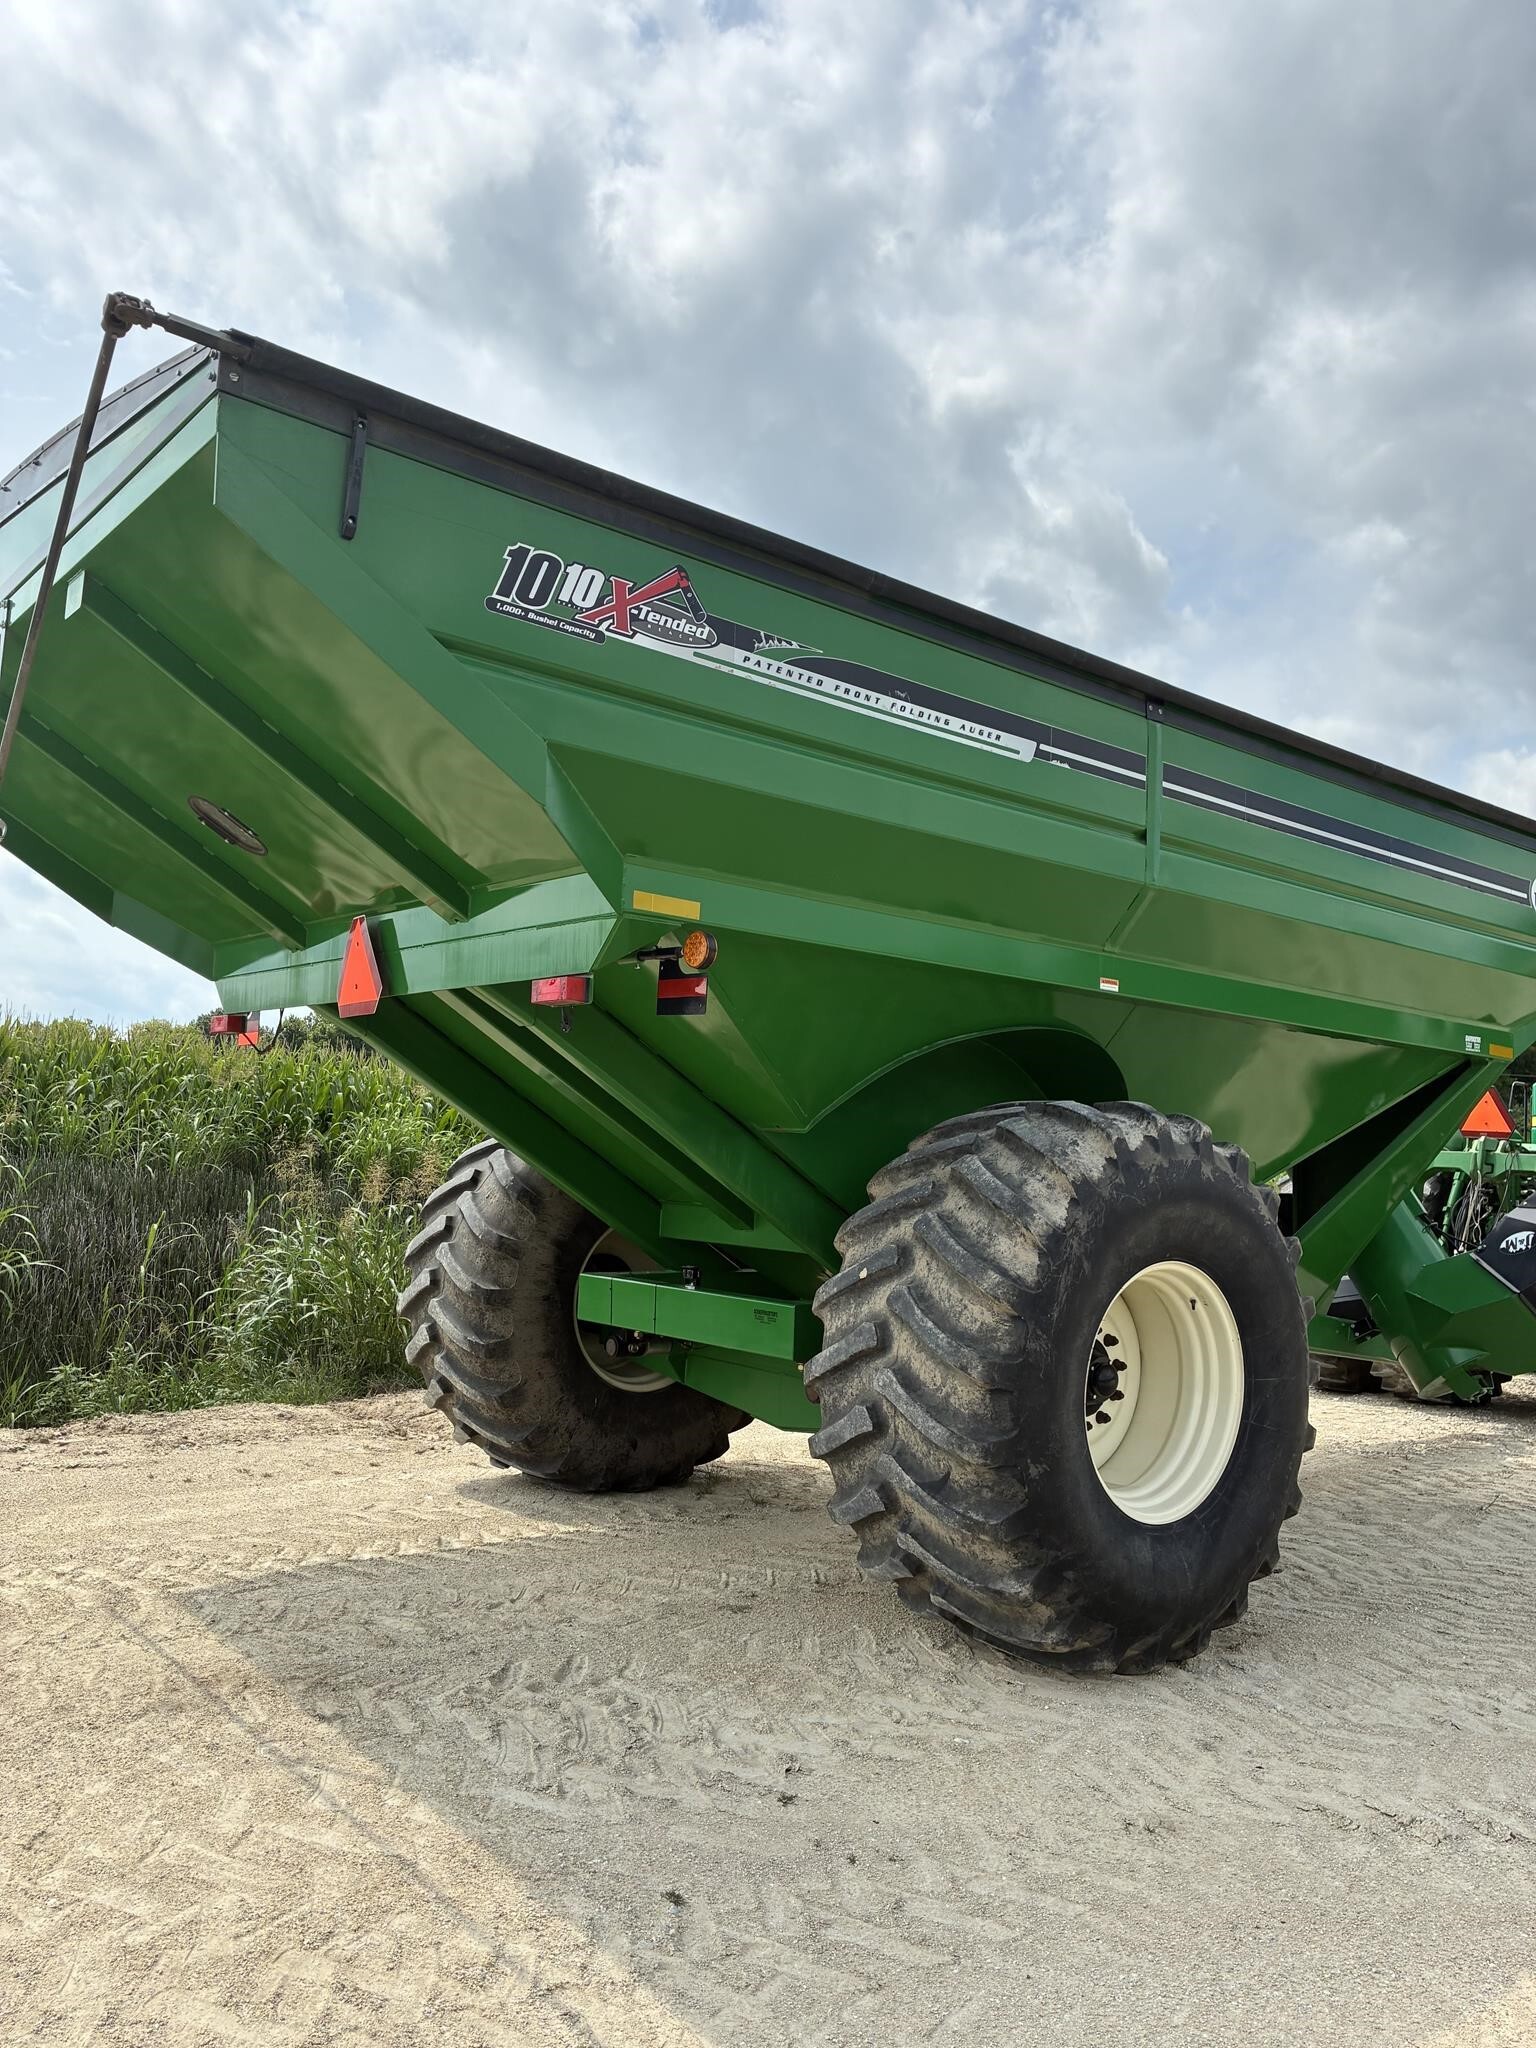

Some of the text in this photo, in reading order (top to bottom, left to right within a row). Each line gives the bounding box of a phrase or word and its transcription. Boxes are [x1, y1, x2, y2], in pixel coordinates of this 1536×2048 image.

[496, 602, 596, 639] 1,000+ Bushel Capacity
[742, 655, 1002, 741] PATENTED FRONT FOLDING AUGER
